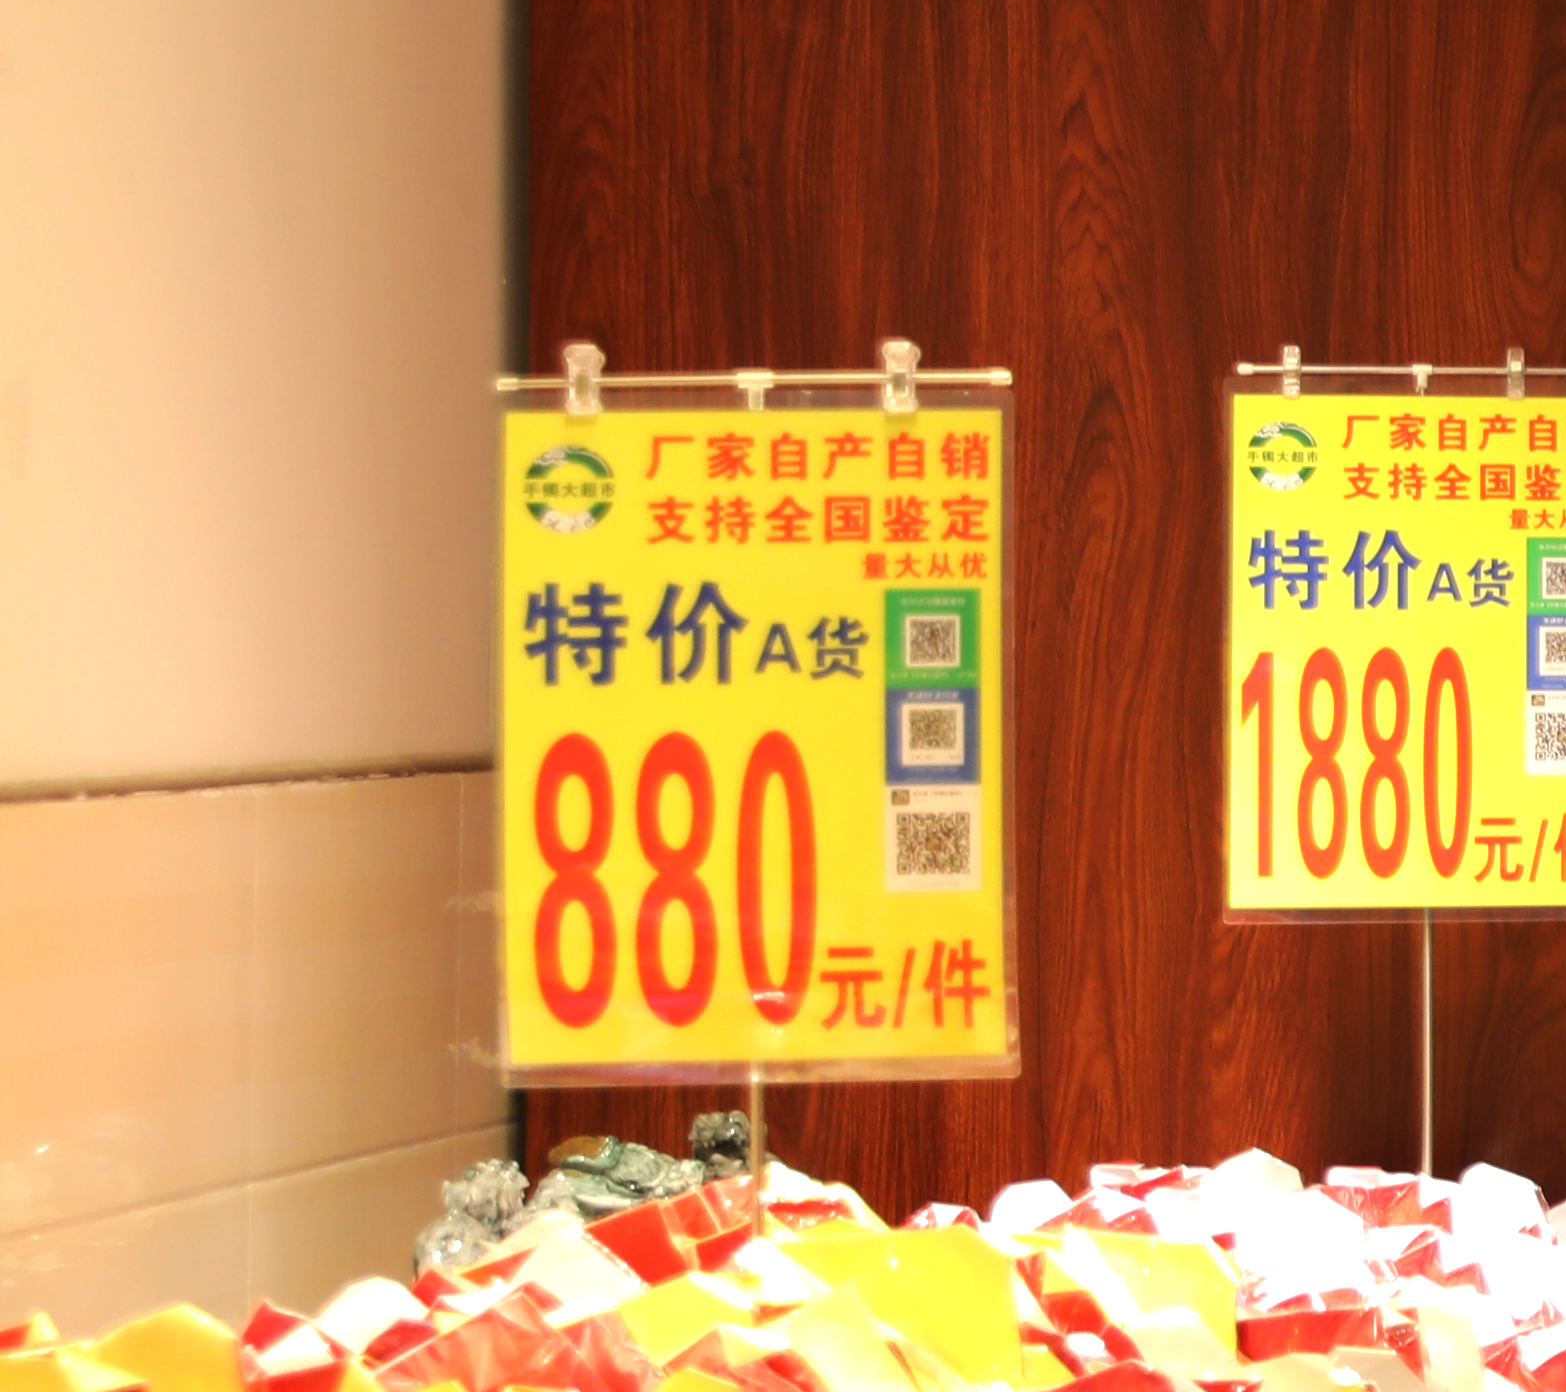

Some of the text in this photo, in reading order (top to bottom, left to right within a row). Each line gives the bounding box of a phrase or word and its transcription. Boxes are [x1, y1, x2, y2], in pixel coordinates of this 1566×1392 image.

[645, 431, 991, 482] 厂家自产自销
[647, 493, 990, 545] 支持全国鉴定
[861, 552, 988, 579] 量大从优
[1247, 529, 1515, 610] 特价A货
[524, 581, 868, 686] 特价A货
[532, 730, 991, 1030] 880元/件
